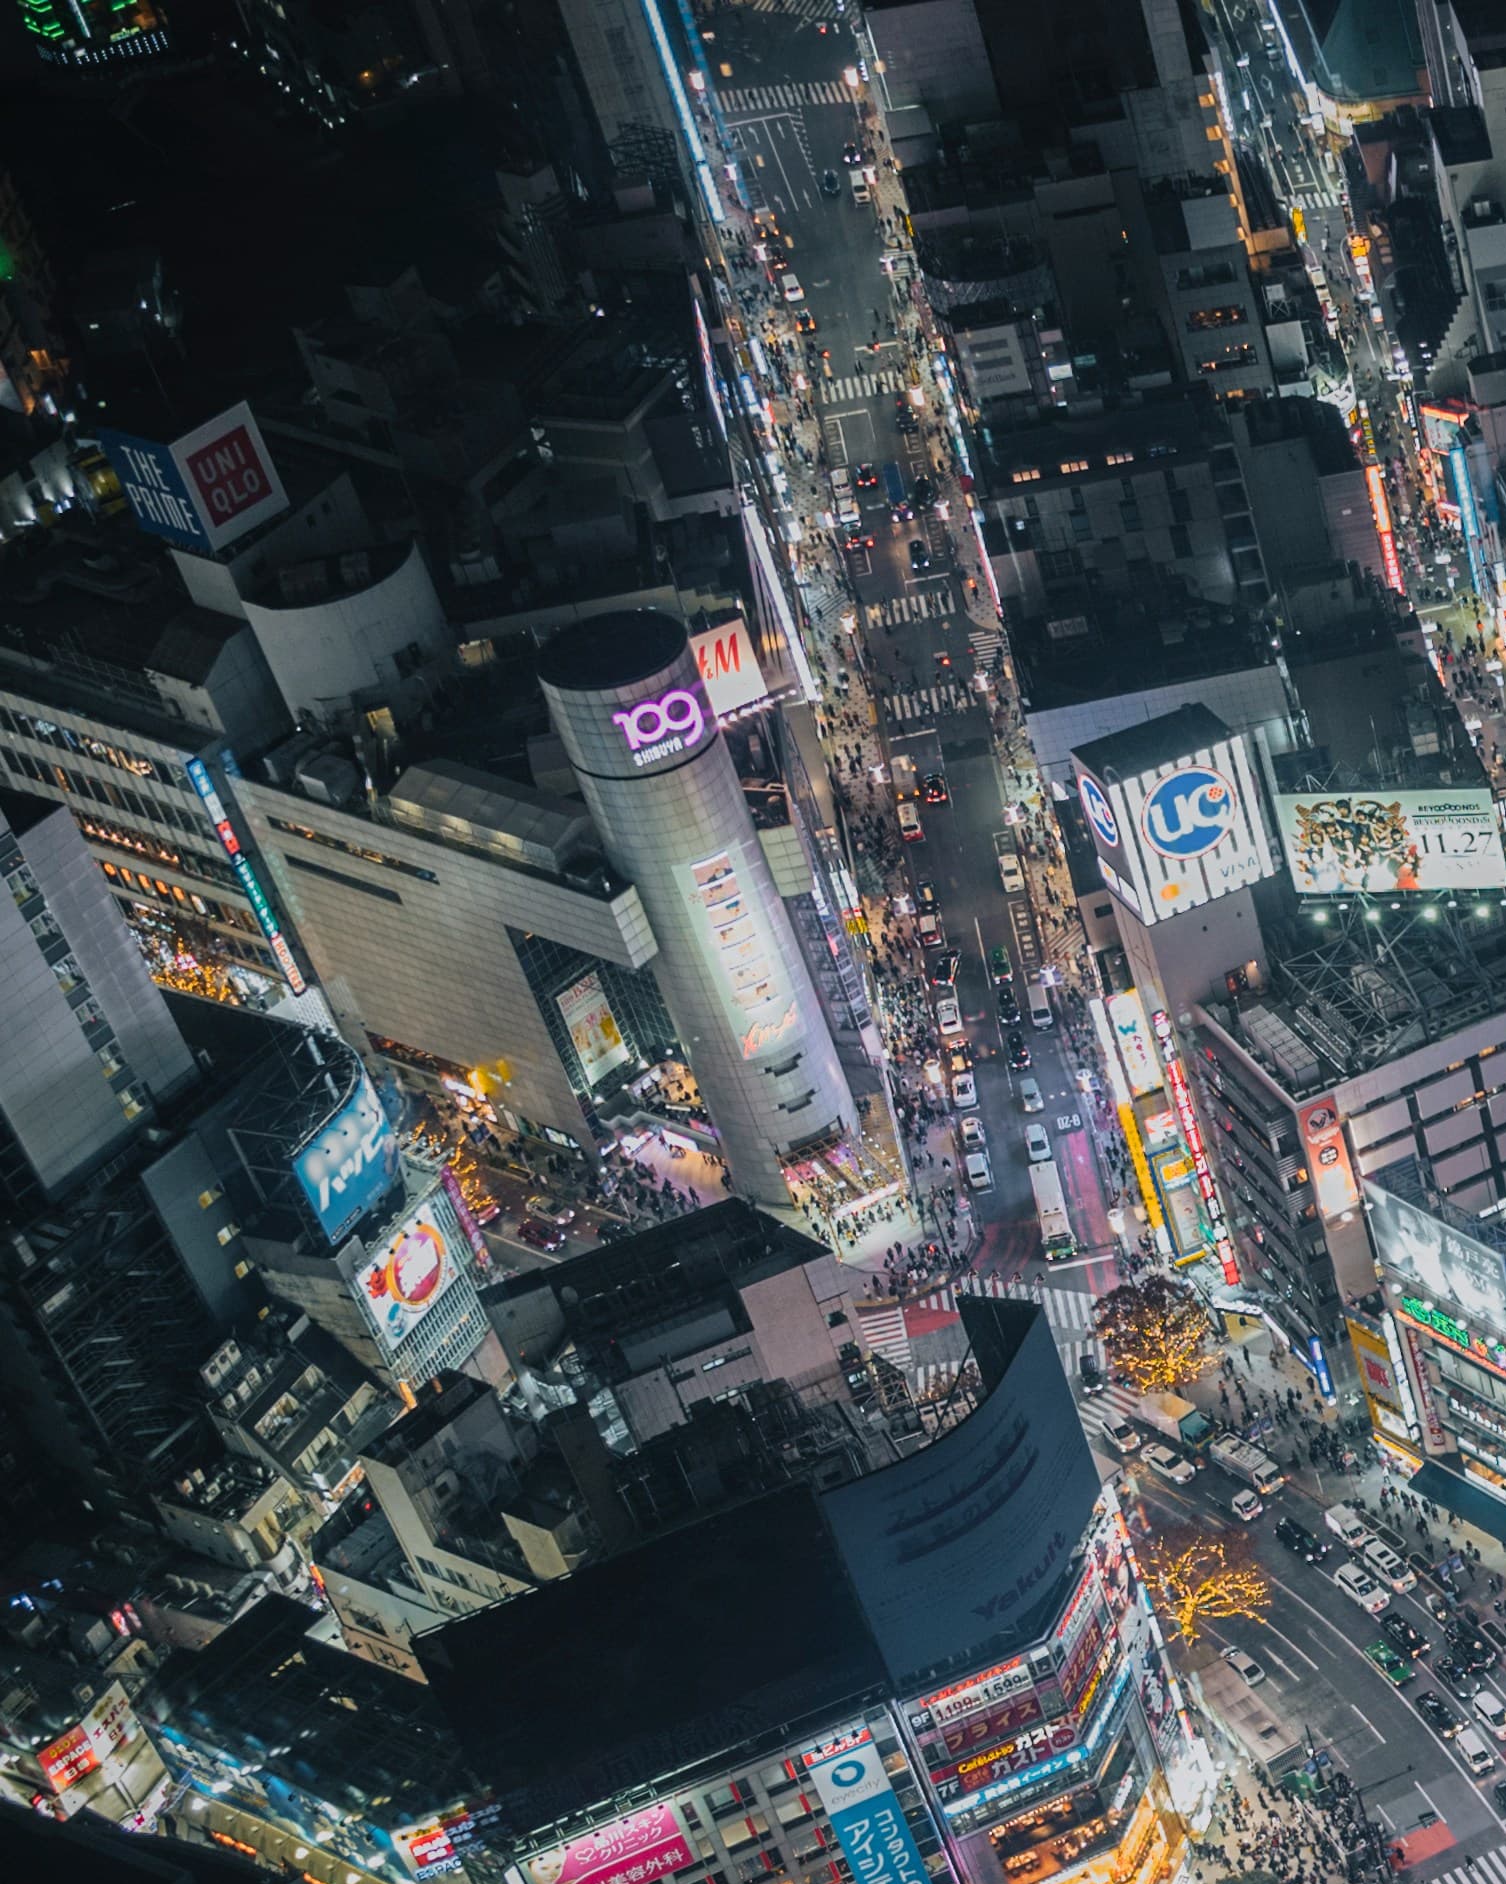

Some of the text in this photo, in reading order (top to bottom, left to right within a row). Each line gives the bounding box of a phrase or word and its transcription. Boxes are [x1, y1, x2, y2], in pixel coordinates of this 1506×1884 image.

[120, 445, 171, 492] THE
[197, 441, 248, 486] UNI
[125, 482, 201, 536] PRIME
[210, 467, 261, 515] QLO
[612, 690, 705, 751] 109
[633, 736, 684, 767] SHIBUYA
[1150, 783, 1231, 843] UC
[1420, 831, 1494, 856] 11.27
[911, 1711, 931, 1729] 9F
[937, 1780, 960, 1798] 7F
[599, 1827, 663, 1862] クリニック
